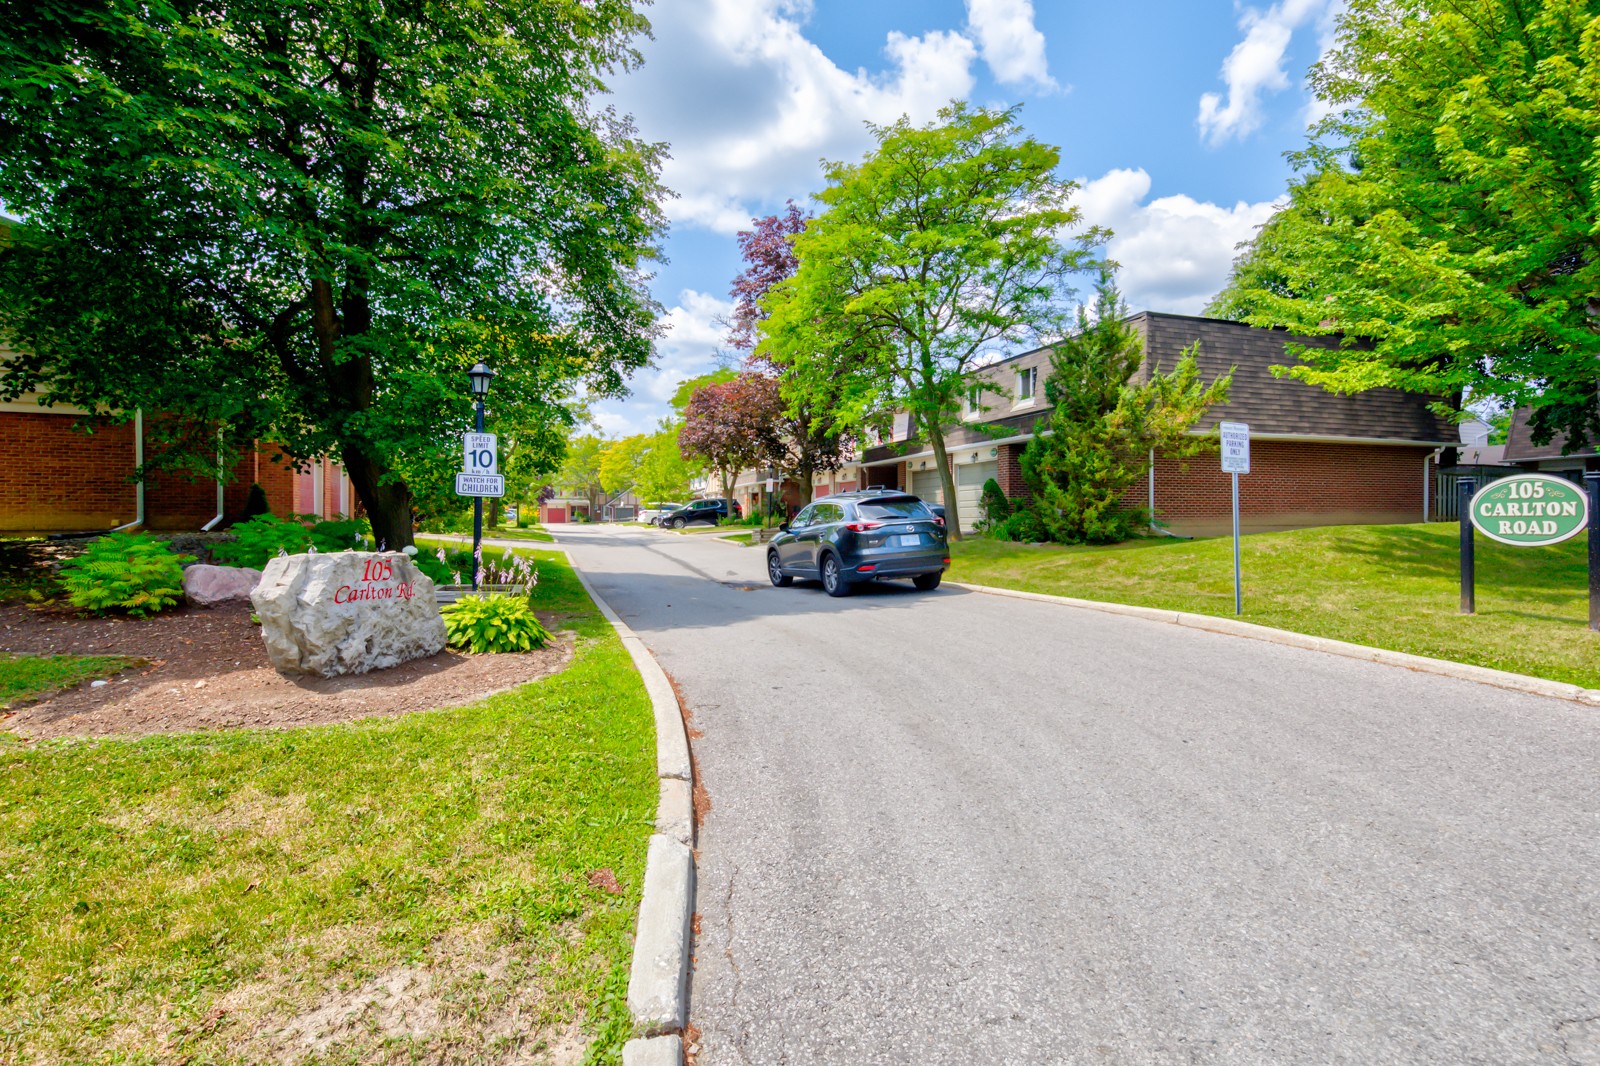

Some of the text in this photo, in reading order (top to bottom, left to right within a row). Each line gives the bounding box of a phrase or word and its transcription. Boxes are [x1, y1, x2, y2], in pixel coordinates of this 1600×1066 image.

[1223, 432, 1248, 440] AUTHORIZED
[1226, 440, 1244, 448] PARKING
[468, 450, 493, 468] 10
[462, 484, 498, 492] CHILDREN
[1508, 482, 1544, 499] 105
[1480, 501, 1577, 516] CARLTON
[1498, 520, 1558, 535] ROAD
[361, 558, 392, 582] 105
[334, 582, 392, 604] Carlton
